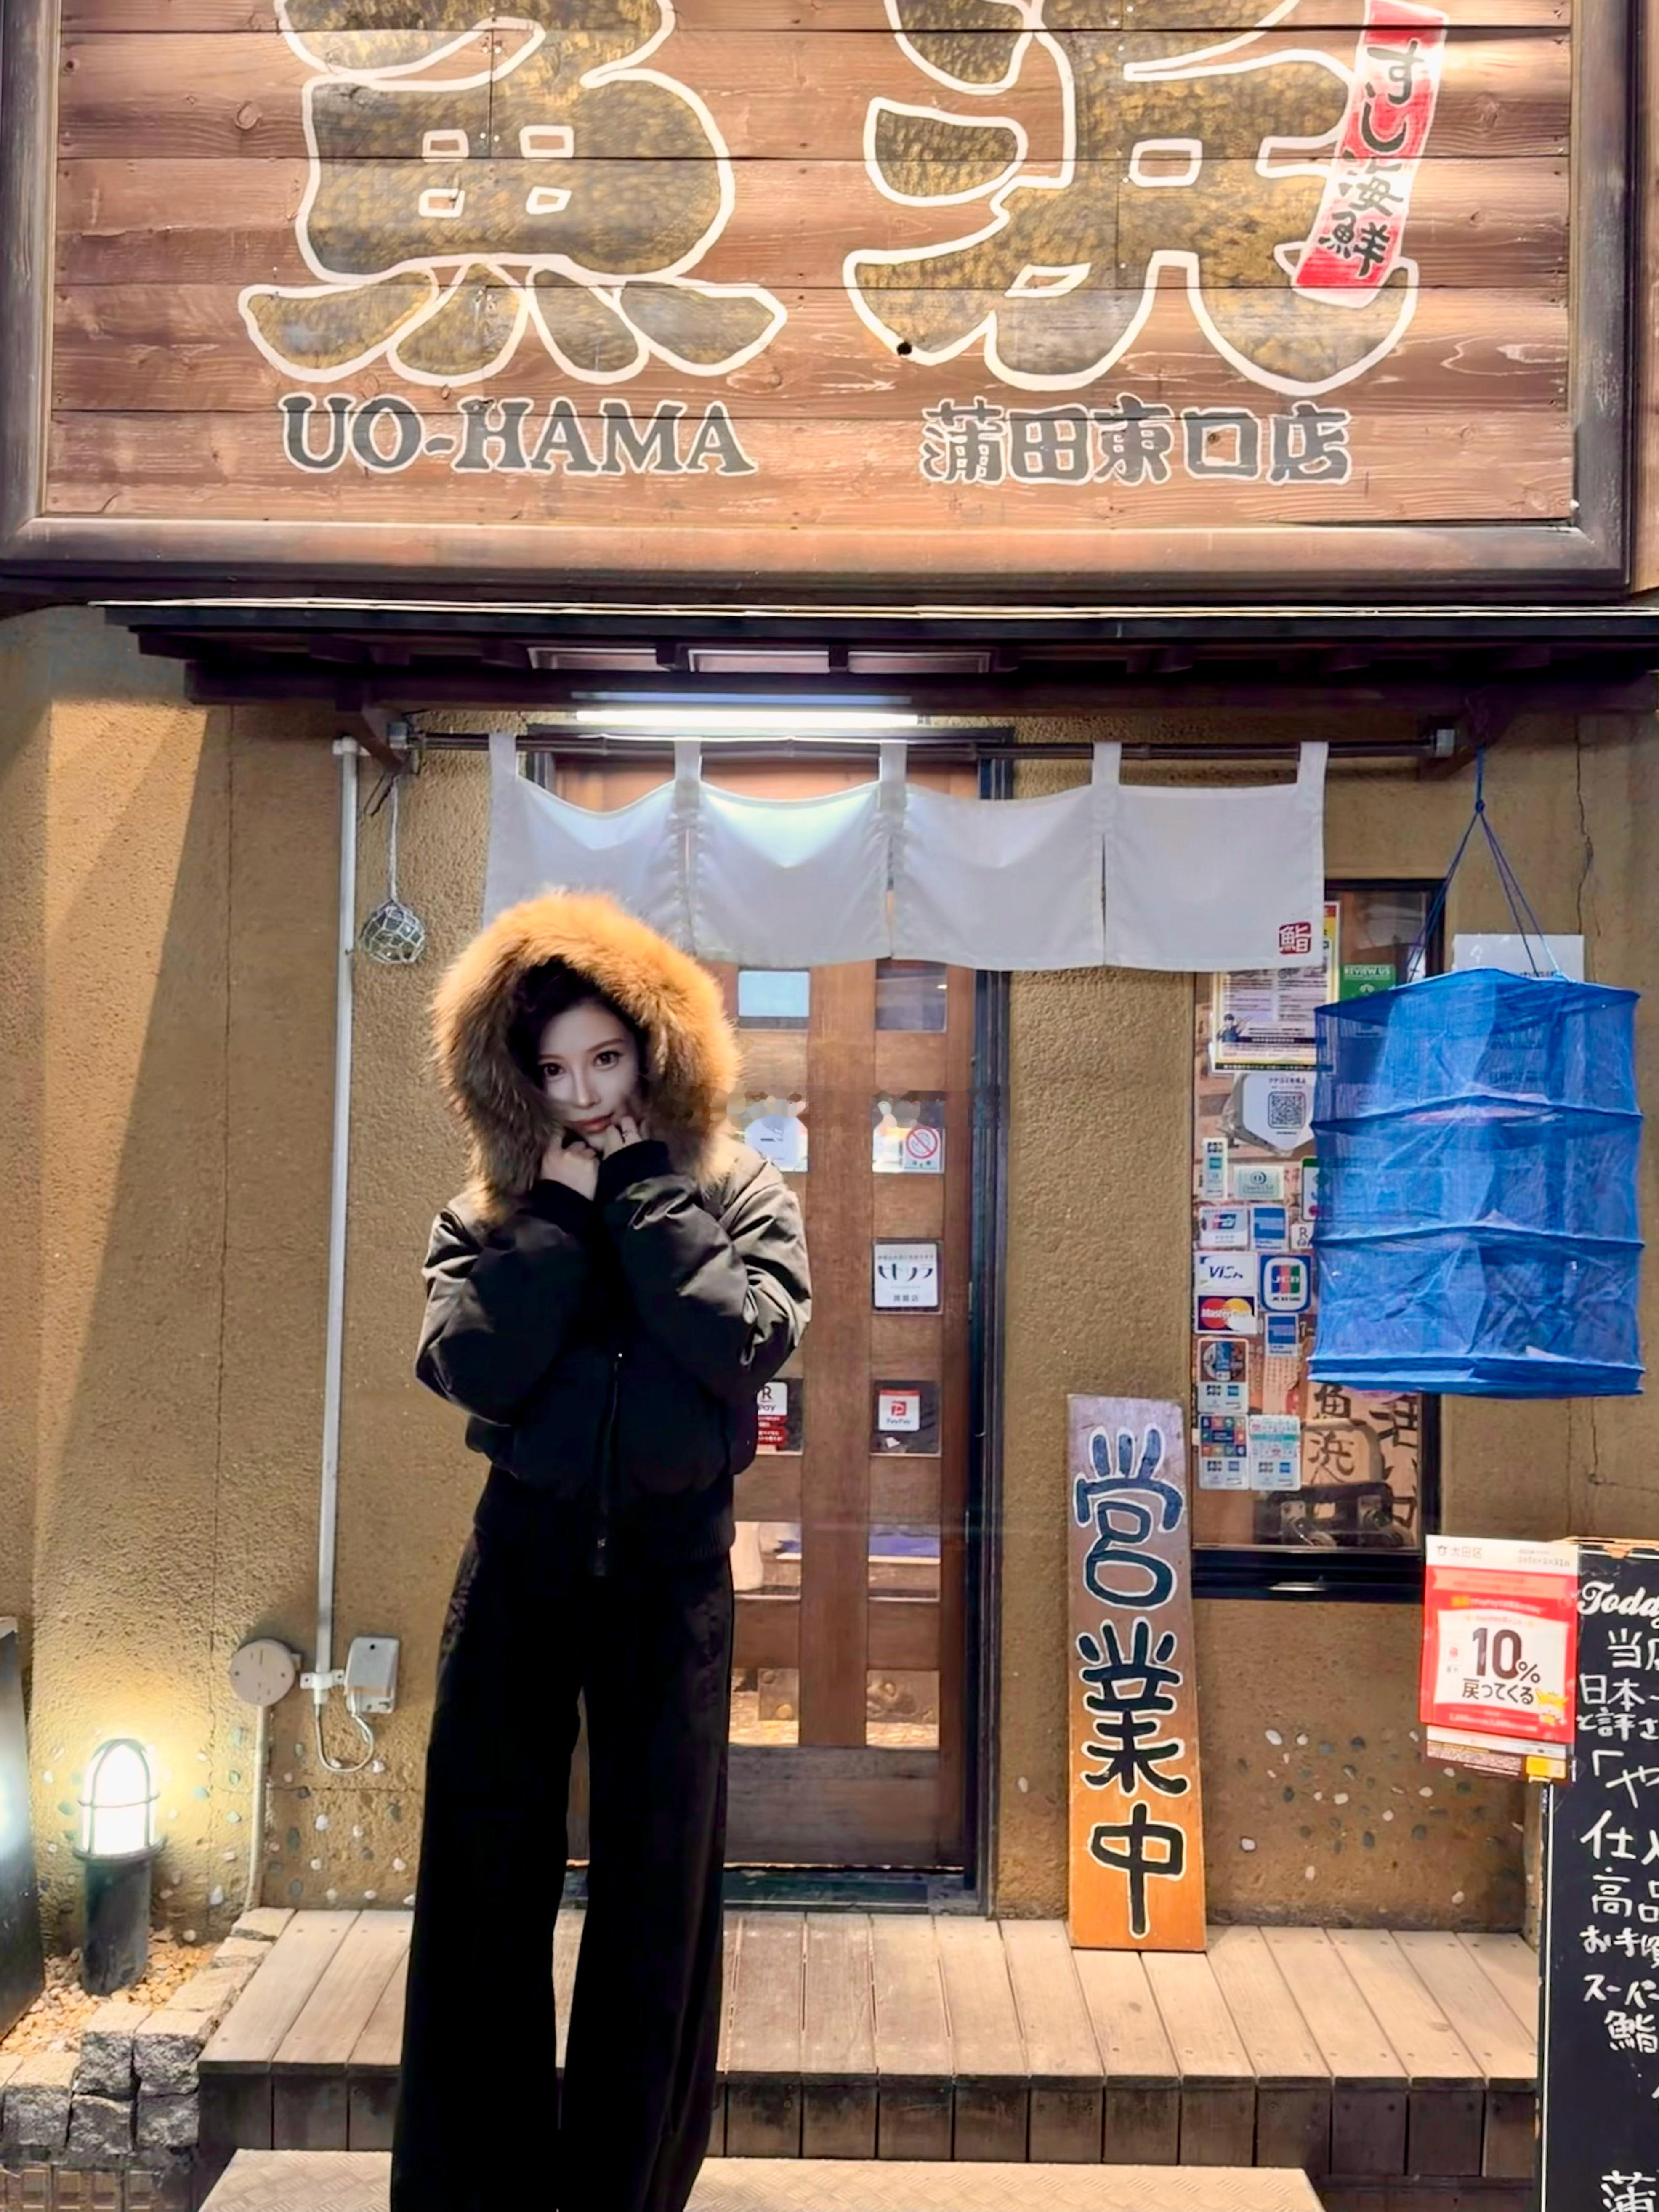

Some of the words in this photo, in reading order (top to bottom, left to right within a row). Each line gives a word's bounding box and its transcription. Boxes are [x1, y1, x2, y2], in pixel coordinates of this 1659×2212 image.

[277, 392, 758, 476] UO-HAMA
[919, 394, 1354, 486] 蒲田東口店
[1279, 923, 1311, 954] 鮨
[1577, 1580, 1659, 1629] Toda
[1073, 1425, 1191, 1938] 営業中
[1472, 1627, 1541, 1684] 10%
[1462, 1678, 1534, 1705] 戻ってくる
[1604, 2010, 1659, 2054] 鮨
